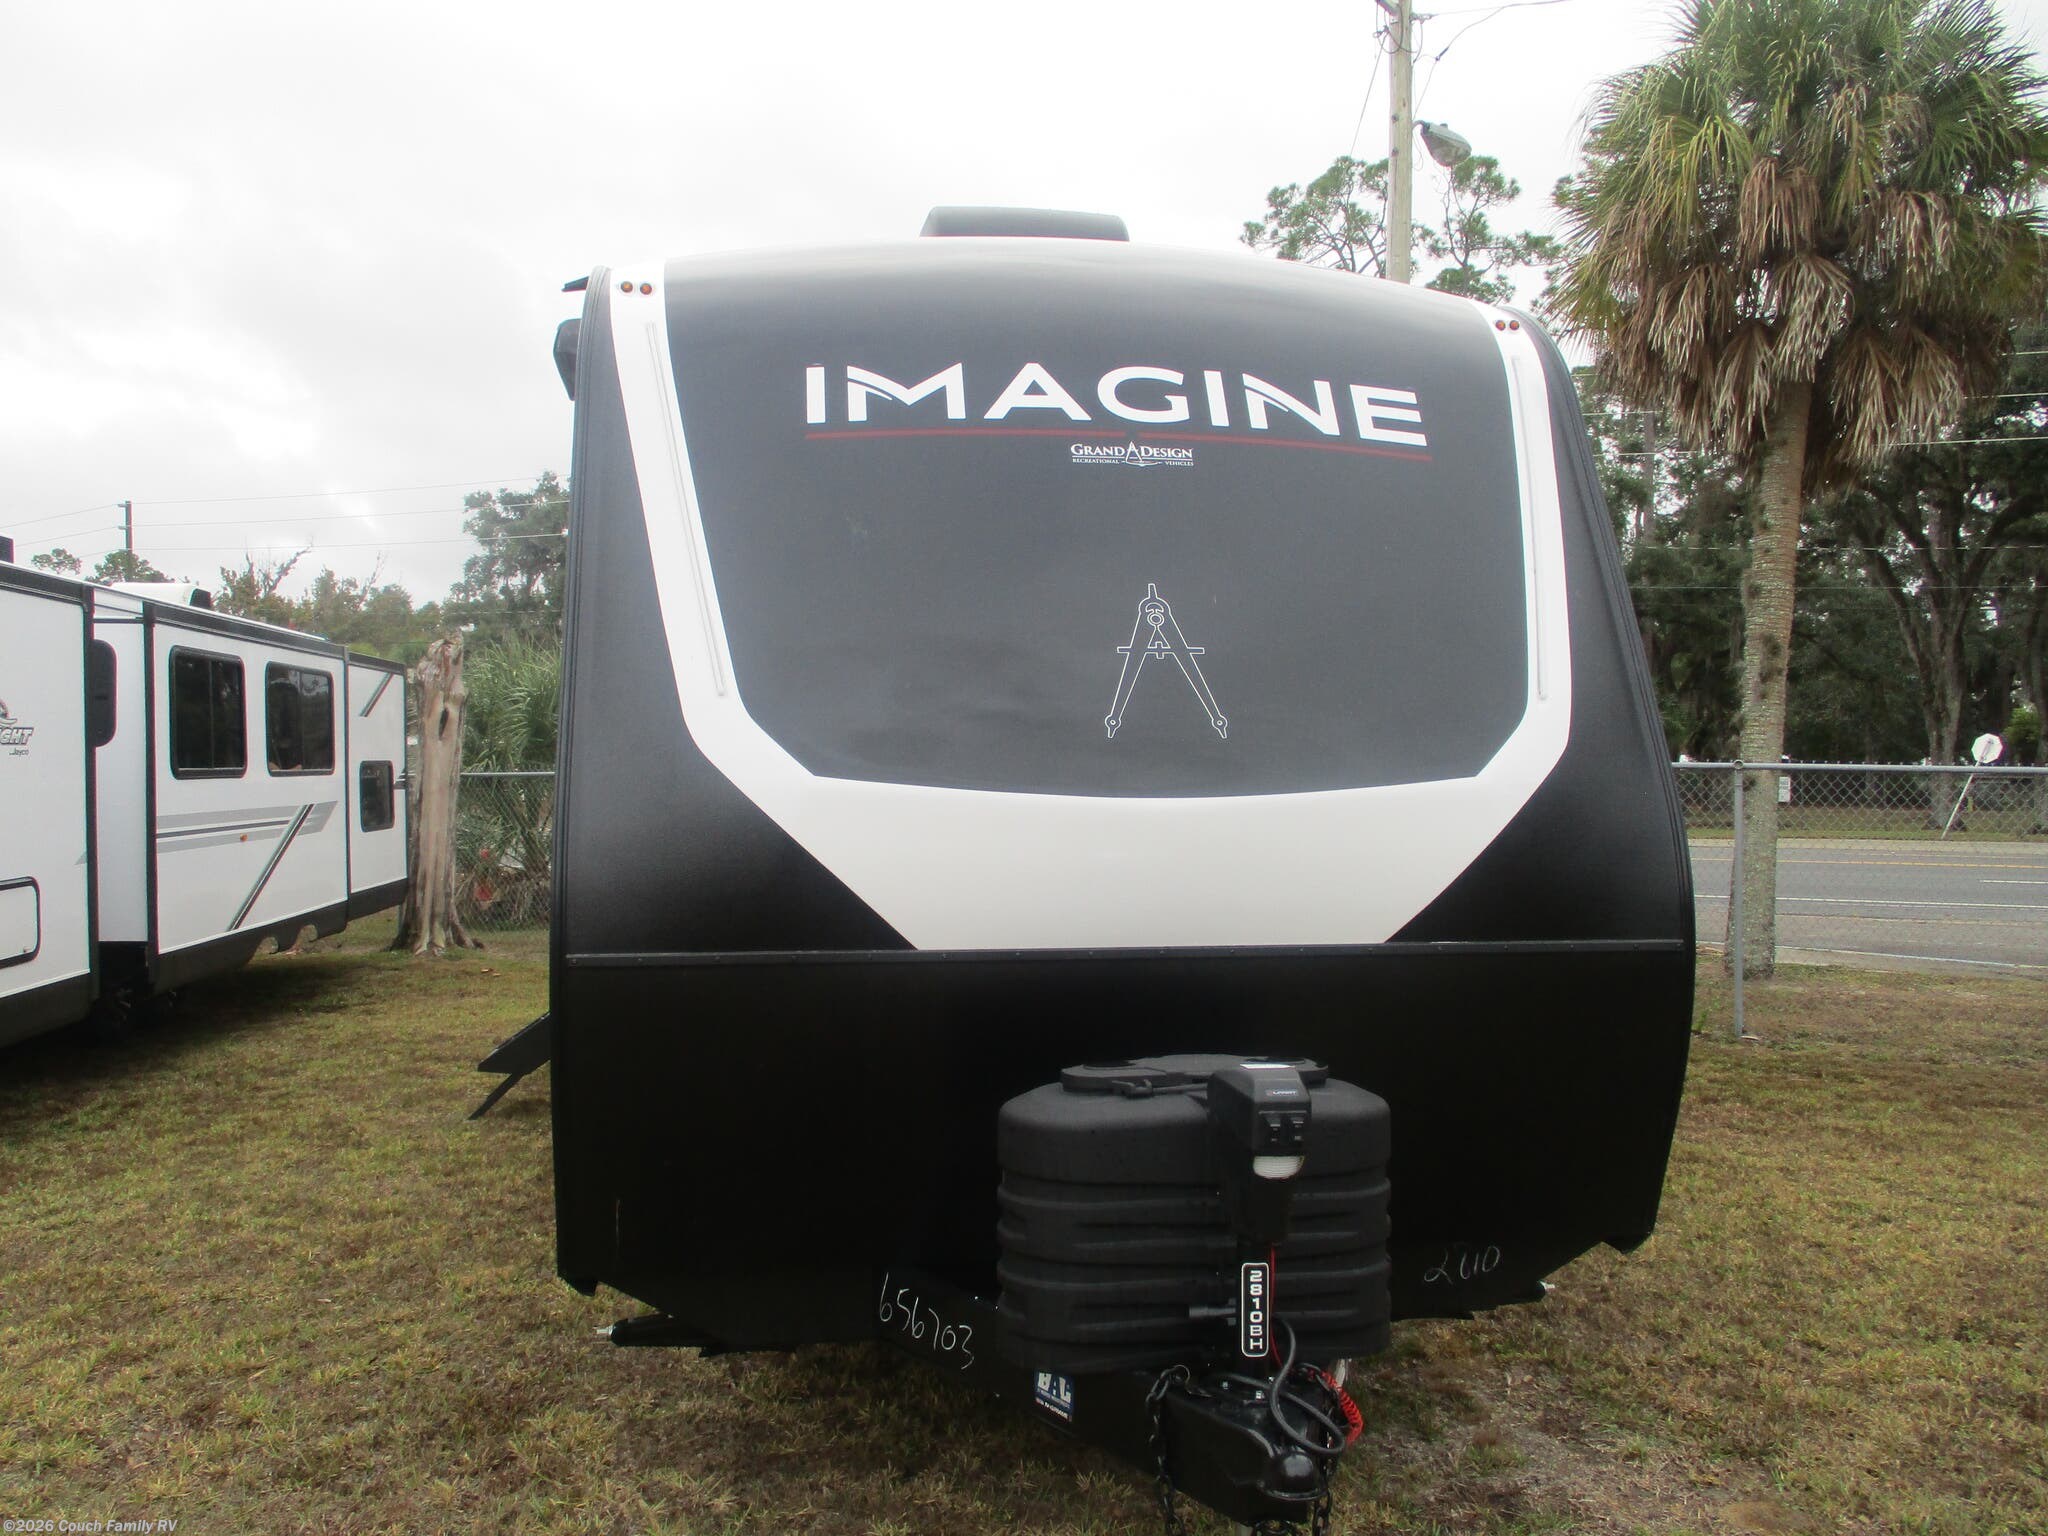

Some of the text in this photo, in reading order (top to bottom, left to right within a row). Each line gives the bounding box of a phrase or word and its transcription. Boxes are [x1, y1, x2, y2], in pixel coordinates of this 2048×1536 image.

[806, 362, 1427, 446] IMAGINE
[1070, 443, 1193, 458] GRAND DESIGN
[0, 727, 34, 746] GHT
[879, 1272, 975, 1370] 656703
[1249, 1269, 1263, 1350] 2810BH
